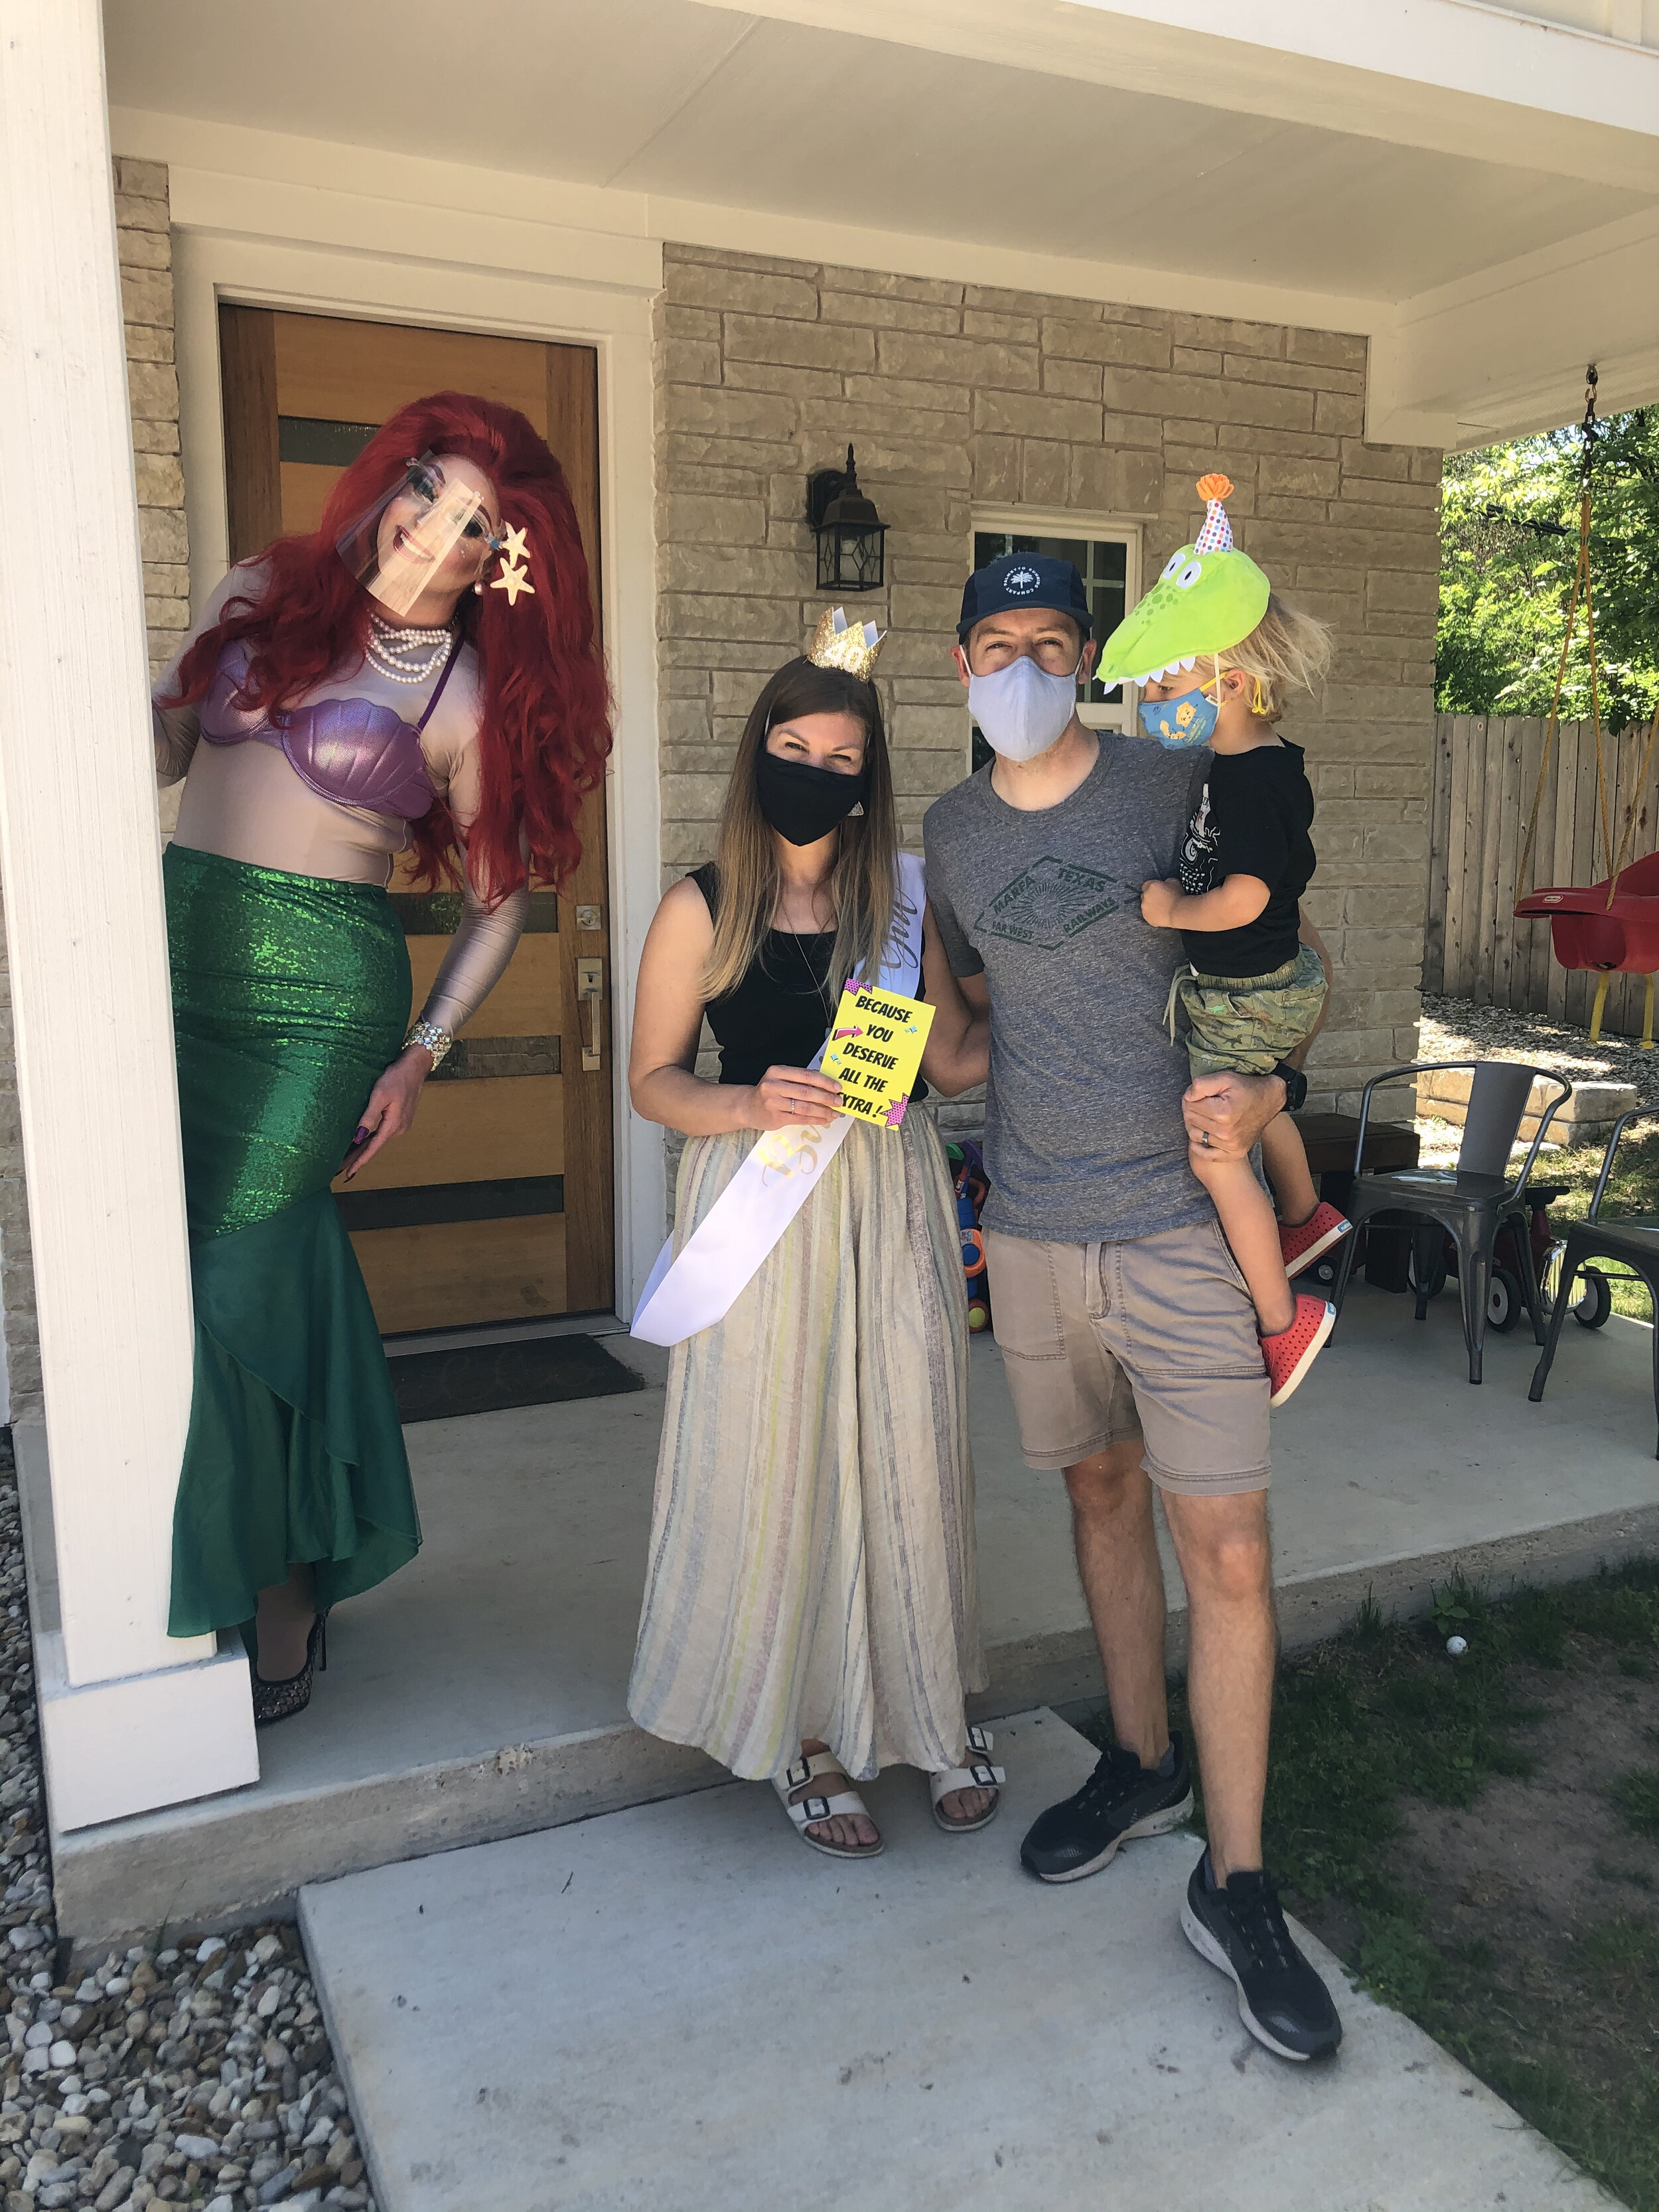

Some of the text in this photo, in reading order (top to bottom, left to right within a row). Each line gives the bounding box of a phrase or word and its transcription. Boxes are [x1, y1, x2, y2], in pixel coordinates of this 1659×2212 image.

[1003, 566, 1041, 589] PALMETTO RUNNING
[1005, 587, 1034, 595] COMPANY
[824, 640, 864, 673] 40
[1058, 867, 1106, 893] TEXAS
[1062, 897, 1116, 932] RAILWAYS
[1009, 925, 1035, 940] WEST
[855, 995, 913, 1023] BECAUSE
[866, 1024, 895, 1043] YOU
[842, 1042, 899, 1070] DESERVE
[838, 1067, 889, 1093] ALL THE
